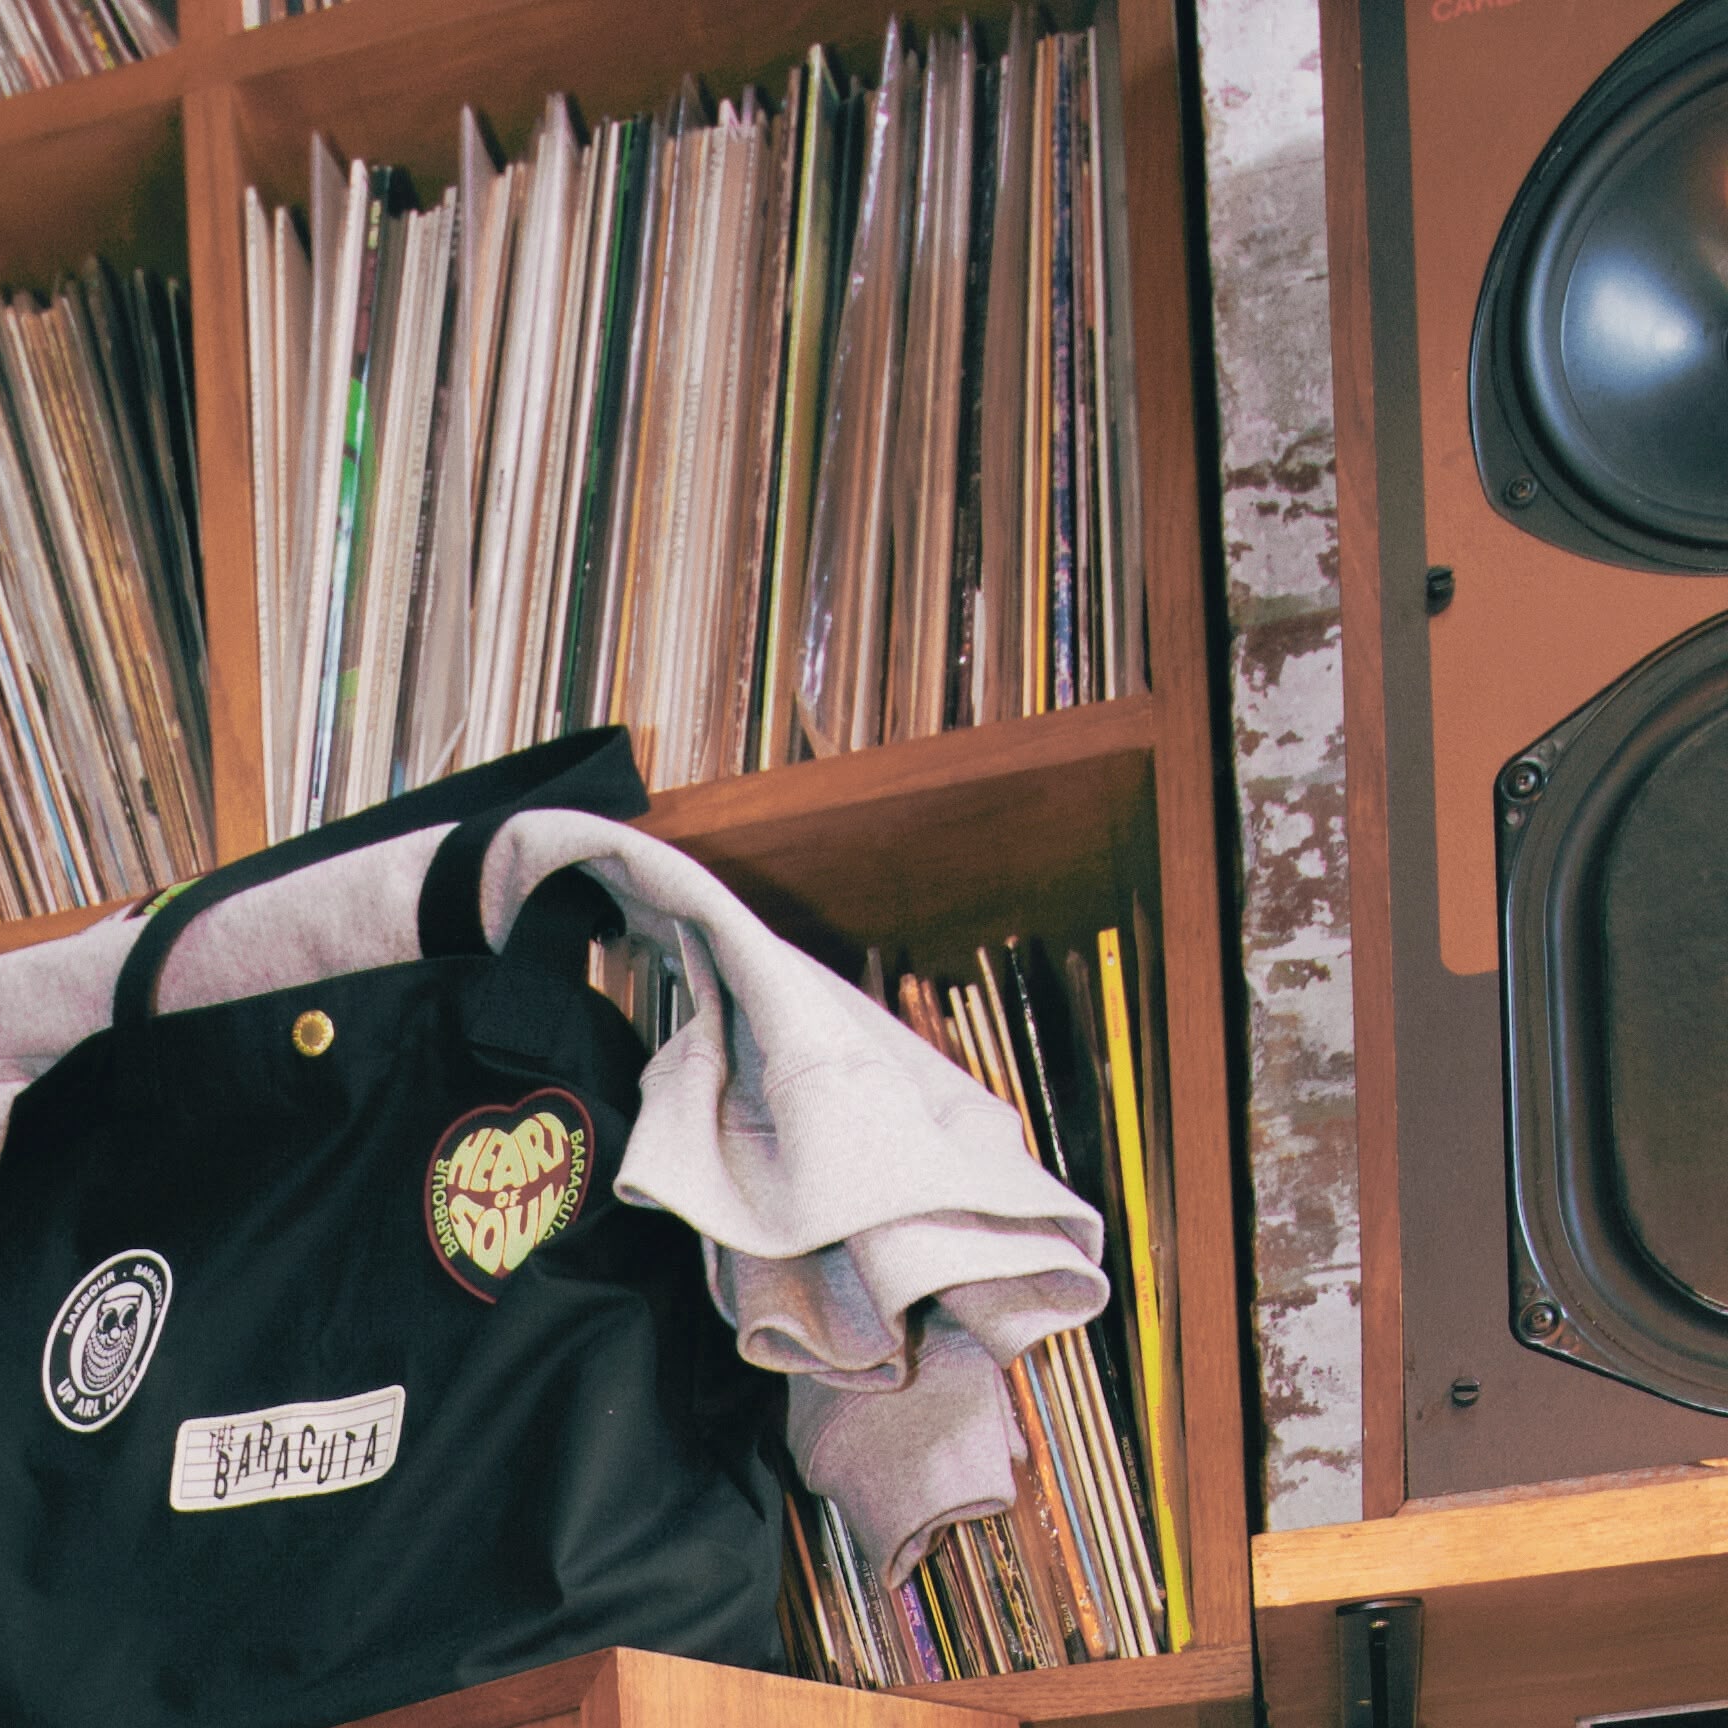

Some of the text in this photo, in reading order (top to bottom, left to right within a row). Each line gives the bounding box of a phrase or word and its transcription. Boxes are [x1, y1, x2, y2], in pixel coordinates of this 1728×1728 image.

[447, 1112, 569, 1192] HEART
[544, 1129, 585, 1241] BARACUTA
[432, 1158, 460, 1259] BARBOUR
[449, 1182, 565, 1275] SOUL
[494, 1189, 522, 1209] OF
[63, 1270, 117, 1336] BARBOUR
[56, 1378, 77, 1404] UP
[208, 1423, 237, 1458] THE
[213, 1420, 379, 1500] BARACUTA
